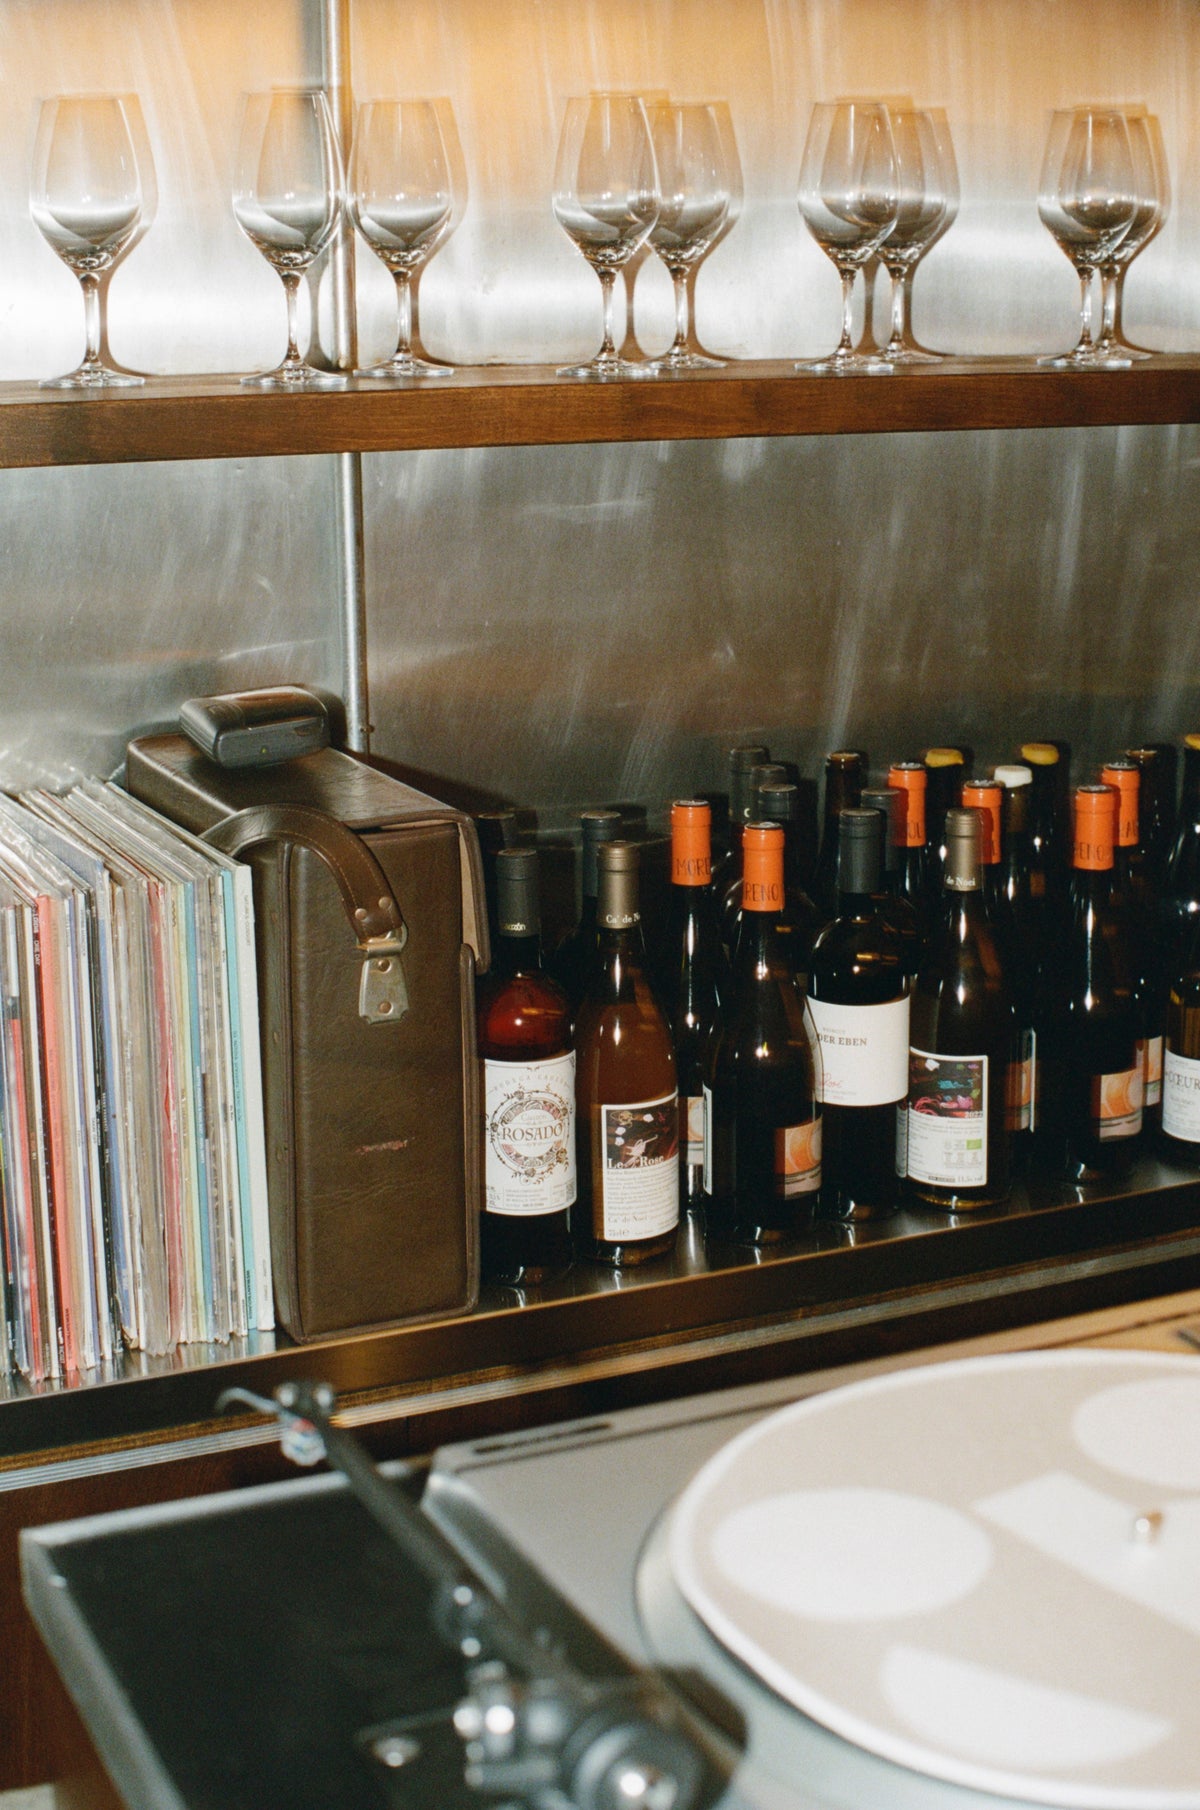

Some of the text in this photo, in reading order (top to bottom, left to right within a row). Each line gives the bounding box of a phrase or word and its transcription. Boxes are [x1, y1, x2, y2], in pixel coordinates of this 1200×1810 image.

[838, 1037, 868, 1047] EBEN
[501, 1122, 563, 1141] ROSADO
[607, 1158, 623, 1169] Le
